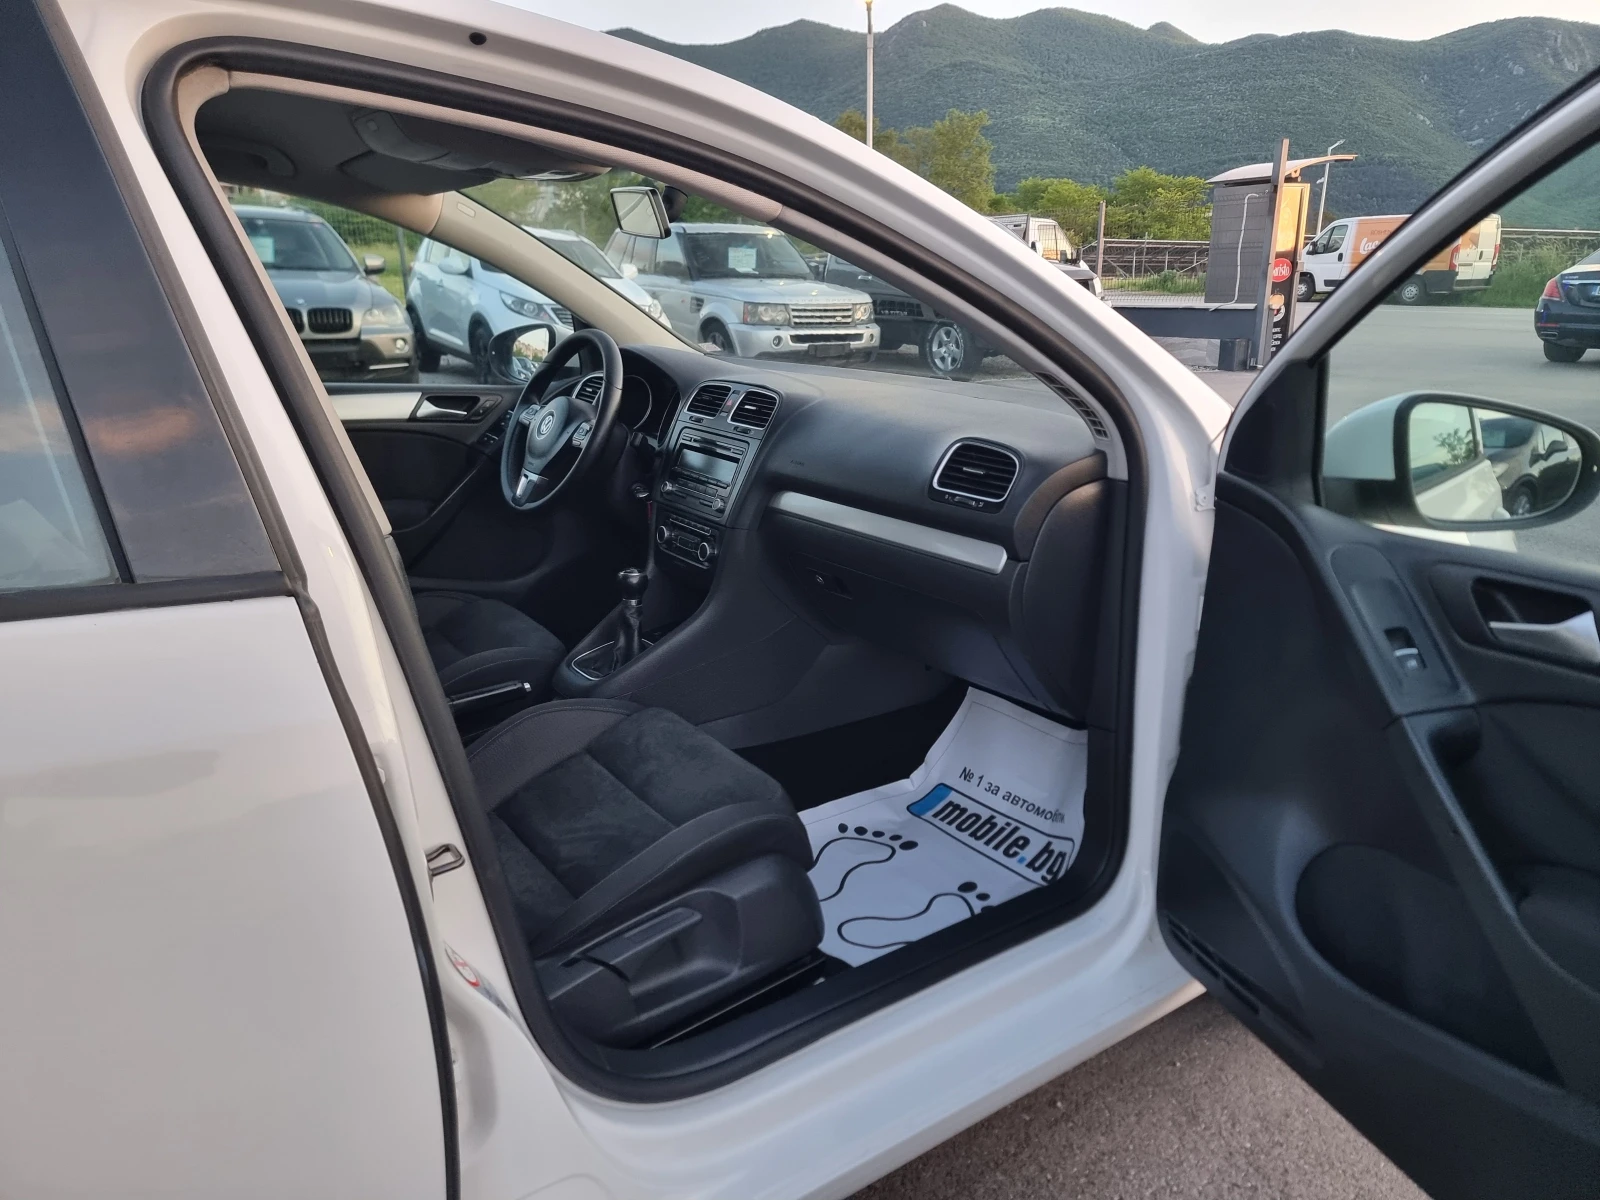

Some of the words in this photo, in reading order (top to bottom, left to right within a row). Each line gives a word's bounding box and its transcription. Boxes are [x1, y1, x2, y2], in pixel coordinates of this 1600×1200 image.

[1273, 263, 1290, 277] aristo
[976, 774, 985, 788] 1
[984, 781, 1001, 797] за
[931, 800, 1068, 884] mobile.bg
